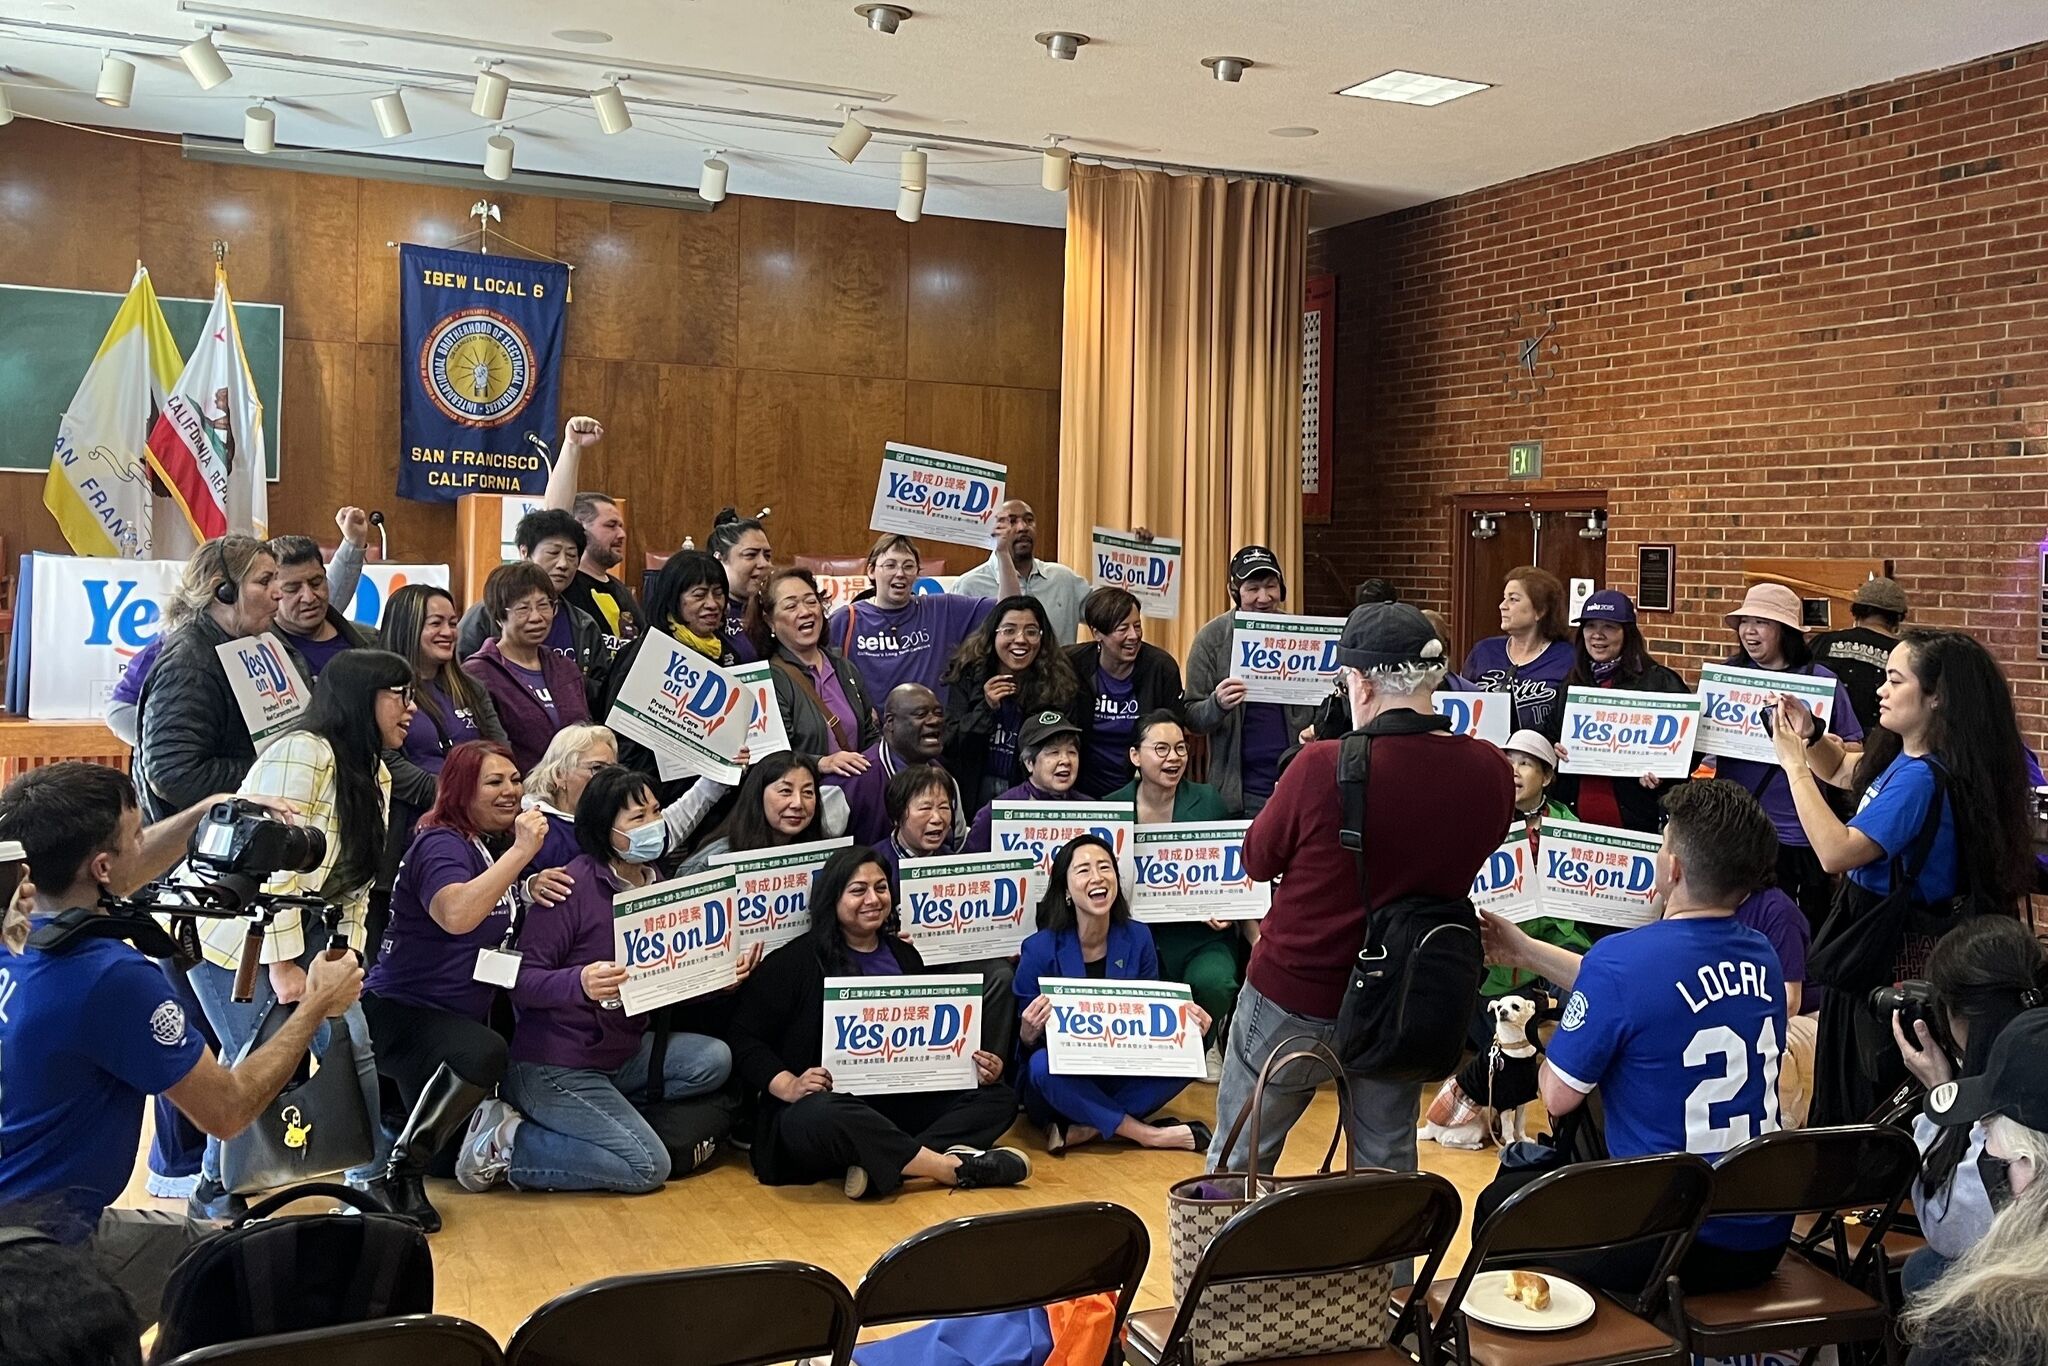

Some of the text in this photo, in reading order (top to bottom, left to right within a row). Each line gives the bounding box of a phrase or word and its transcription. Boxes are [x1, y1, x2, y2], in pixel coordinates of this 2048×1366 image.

[424, 270, 544, 298] IBEW LOCAL 6
[438, 322, 492, 356] BROTHERHOOD
[492, 326, 502, 339] OF
[502, 334, 524, 382] ELECTRICAL
[434, 360, 477, 413] INTERNATIONAL
[485, 383, 520, 414] WORKERS
[168, 396, 214, 468] CALIFORNIA
[412, 447, 539, 470] SAN FRANCISCO
[1513, 448, 1532, 474] EX
[54, 436, 127, 540] AN FRAN
[428, 471, 520, 491] CALIFORNIA
[887, 472, 928, 503] Yes
[932, 491, 960, 509] on
[962, 480, 998, 523] D!
[1098, 554, 1174, 592] Yes on D!
[82, 580, 160, 646] Ye
[857, 632, 899, 650] seiu
[238, 650, 266, 678] Yes
[1240, 640, 1341, 672] Yes on D
[256, 678, 268, 692] on
[664, 680, 682, 696] on
[664, 650, 740, 728] Yes D!
[650, 698, 699, 729] Protect Care
[1120, 699, 1138, 714] 20
[1704, 692, 1745, 723] Yes
[648, 706, 705, 740] Not Corporate Greed
[1571, 714, 1612, 741] Yes
[1618, 728, 1647, 744] on
[1650, 715, 1690, 746] D!
[1134, 846, 1246, 884] Yes on D
[1490, 847, 1523, 889] D!
[1547, 849, 1655, 892] Yes on D
[737, 893, 767, 921] es
[774, 891, 806, 915] on
[909, 877, 1026, 924] Yes on D!
[623, 897, 732, 967] Yes on D!
[1675, 961, 1772, 1014] LOCAL
[834, 1003, 973, 1050] Yes on D!
[1052, 1003, 1187, 1039] Yes on D!
[1682, 1016, 1782, 1154] 21
[1182, 1214, 1196, 1224] MK
[1198, 1205, 1214, 1215] MK
[1183, 1232, 1196, 1243] MK
[1198, 1226, 1213, 1235] MK
[1183, 1251, 1196, 1261] MK
[1231, 1285, 1246, 1294] MK
[1264, 1284, 1278, 1293] MK
[1296, 1281, 1310, 1290] MK
[1214, 1294, 1228, 1303] MK
[1247, 1294, 1262, 1304] MK
[1280, 1292, 1294, 1302] MK
[1213, 1311, 1228, 1320] MK
[1230, 1304, 1245, 1312] MK
[1246, 1314, 1261, 1322] MK
[1264, 1303, 1278, 1313] MK
[1280, 1312, 1294, 1321] MK
[1196, 1319, 1211, 1330] MK
[1230, 1322, 1244, 1331] MK
[1263, 1322, 1278, 1332] MK
[1196, 1339, 1210, 1349] MK
[1212, 1330, 1227, 1340] MK
[1246, 1332, 1260, 1342] MK
[1211, 1350, 1226, 1360] MK
[1228, 1342, 1243, 1351] MK
